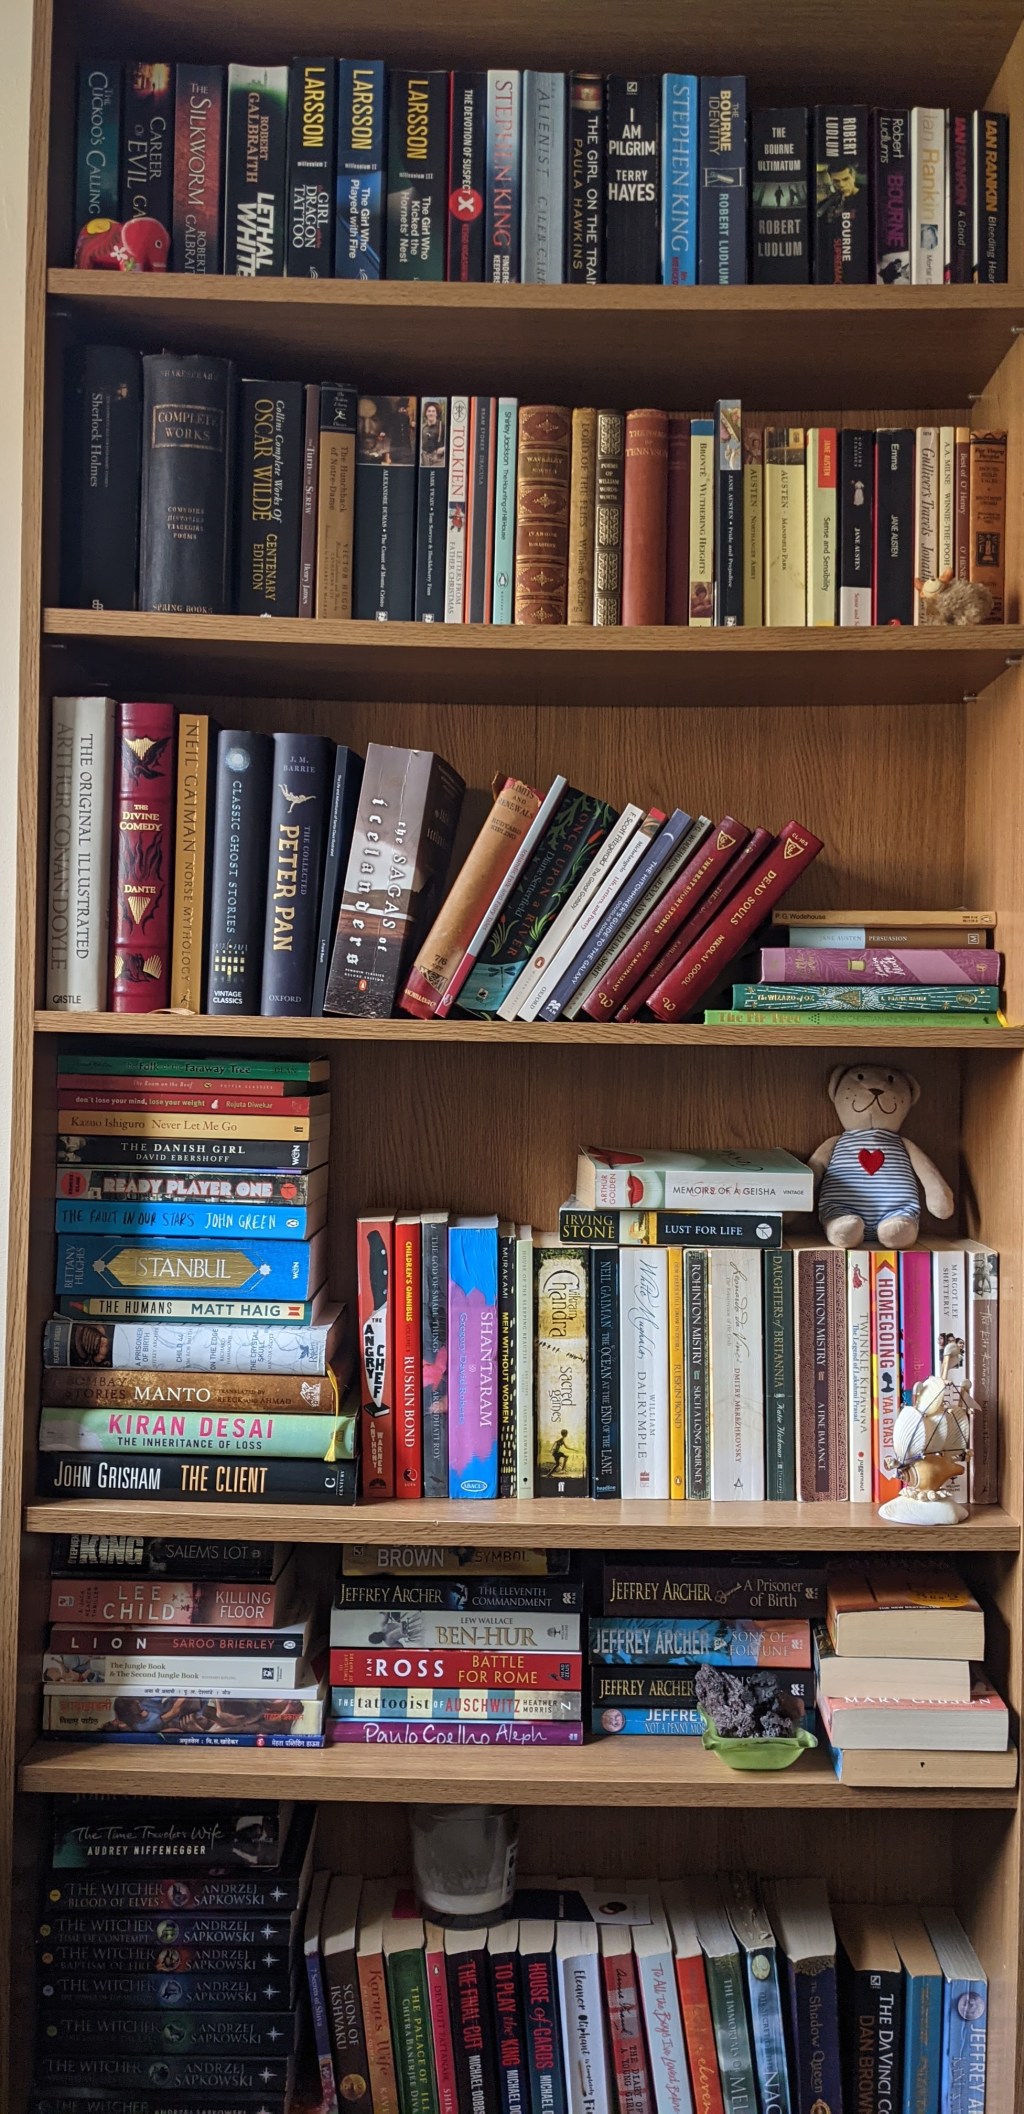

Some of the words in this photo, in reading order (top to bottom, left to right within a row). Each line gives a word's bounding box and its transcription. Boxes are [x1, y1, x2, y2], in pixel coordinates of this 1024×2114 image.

[302, 67, 326, 147] LARSSON
[351, 69, 374, 149] LARSSON
[464, 89, 473, 105] THE
[406, 80, 429, 160] LARSSON
[463, 107, 473, 144] DEVOTION
[493, 80, 513, 181] STEPHEN
[672, 84, 690, 187] STEPHEN
[720, 90, 732, 151] BOURNE
[826, 116, 839, 157] LUDLUM
[843, 117, 857, 156] ROBERT
[150, 116, 166, 180] CAREER
[188, 98, 212, 206] SILKWORM
[246, 92, 260, 183] GALBRAITH
[259, 115, 269, 161] ROBERT
[463, 146, 473, 156] OF
[608, 140, 656, 156] PILGRIM
[127, 139, 147, 189] EVIL
[462, 158, 472, 194] SUSPECT
[573, 138, 583, 189] PAULA
[616, 169, 648, 181] TERRY
[350, 179, 360, 212] Played
[360, 188, 371, 204] The
[608, 183, 655, 201] HAYES
[349, 213, 359, 236] with
[360, 207, 371, 227] Girl
[492, 189, 513, 247] KING
[671, 193, 689, 252] KING
[718, 193, 729, 236] ROBERT
[349, 238, 359, 259] Fire
[360, 229, 370, 251] Who
[572, 198, 583, 270] HAWKINS
[841, 212, 852, 262] BOURNE
[718, 240, 729, 285] LUDLUM
[91, 392, 103, 442] Sherlock
[253, 399, 274, 460] OSCAR
[504, 411, 512, 435] Shirley
[164, 427, 210, 441] WORKS
[90, 444, 102, 488] Holmes
[452, 427, 465, 498] TOLKIEN
[501, 438, 509, 466] Jackson
[890, 443, 900, 470] Emma
[252, 465, 273, 522] WILDE
[699, 483, 708, 536] WUTHERING
[823, 517, 831, 538] Sense
[890, 514, 899, 532] JANE
[942, 492, 951, 567] WINNIE-THE-POOH
[698, 537, 707, 575] HEIGHTS
[890, 533, 899, 558] AUSTEN
[252, 543, 264, 591] EDITION
[265, 533, 277, 601] CENTENARY
[80, 734, 94, 766] THE
[184, 723, 200, 771] NEIL
[283, 764, 316, 774] BARRIE
[78, 770, 93, 845] ORIGINAL
[122, 811, 160, 821] DIVINE
[182, 775, 198, 856] GAIMAN
[230, 780, 242, 831] CLASSIC
[119, 821, 162, 832] COMEDY
[228, 834, 240, 878] GHOST
[272, 824, 300, 901] PETER
[124, 884, 156, 894] DANTE
[184, 861, 195, 902] NORSE
[753, 869, 778, 898] DEAD
[76, 852, 92, 960] ILLUSTRATED
[226, 881, 239, 935] STORIES
[730, 895, 756, 927] SOULS
[50, 897, 69, 971] DOYLE
[273, 906, 296, 952] PAN
[181, 906, 194, 987] MYTHOLOGY
[700, 934, 726, 964] NIKOLAI
[680, 963, 702, 987] GOGOL
[212, 997, 244, 1005] CLASSICS
[213, 990, 243, 998] VINTAGE
[71, 1117, 103, 1127] Kazuo
[104, 1118, 145, 1130] Ishiguro
[151, 1120, 182, 1130] Never
[183, 1121, 201, 1131] Let
[202, 1121, 220, 1131] Me
[221, 1121, 238, 1131] Go
[136, 1153, 167, 1162] DAVID
[170, 1154, 231, 1163] EBERSHOFF
[153, 1143, 206, 1153] DANISH
[212, 1145, 246, 1155] GIRL
[562, 1226, 615, 1240] STONE
[664, 1224, 693, 1235] LUST
[695, 1225, 718, 1236] FOR
[720, 1225, 743, 1237] LIFE
[405, 1240, 413, 1284] CHILDREN'S
[501, 1246, 509, 1300] MURAKAMI
[99, 1300, 120, 1314] THE
[124, 1301, 173, 1315] HUMANS
[190, 1303, 235, 1316] MATT
[240, 1304, 282, 1317] HAIG
[405, 1286, 413, 1322] OMNIBUS
[878, 1278, 895, 1369] HOMEGOING
[816, 1327, 826, 1367] MISTRY
[403, 1355, 416, 1406] RUSKIN
[479, 1311, 494, 1428] SHANTARAM
[133, 1386, 211, 1403] MANTO
[501, 1383, 509, 1424] WOMEN
[883, 1395, 893, 1416] YAA
[109, 1413, 186, 1436] KIRAN
[199, 1417, 274, 1439] DESAI
[403, 1409, 416, 1448] BOND
[637, 1371, 647, 1459] DALRYMPLE
[118, 1437, 137, 1446] THE
[142, 1438, 213, 1449] INHERITANCE
[218, 1440, 231, 1449] OF
[236, 1440, 262, 1450] LOSS
[883, 1418, 894, 1448] GYASI
[215, 1591, 271, 1605] KILLING
[498, 1587, 547, 1597] ELEVENTH
[609, 1578, 660, 1602] JEFFREY
[662, 1579, 713, 1602] ARCHER
[103, 1603, 175, 1621] CHILD
[220, 1605, 265, 1619] FLOOR
[478, 1617, 514, 1625] WALLACE
[435, 1625, 538, 1647] BEN-HUR
[124, 1662, 148, 1671] Jungle
[130, 1671, 156, 1679] Second
[375, 1658, 444, 1677] ROSS
[458, 1670, 488, 1684] FOR
[494, 1671, 538, 1684] ROME
[472, 1656, 525, 1669] BATTLE
[357, 1696, 430, 1710] tattooist
[445, 1698, 521, 1714] AUSCHWITZ
[523, 1706, 553, 1714] MORRIS
[363, 1722, 419, 1744] Paulo
[422, 1724, 490, 1745] Coelho
[495, 1723, 548, 1745] Aleph
[87, 1845, 128, 1856] AUDREY
[133, 1845, 206, 1856] NIFFENEGGER
[193, 1893, 265, 1906] SAPKOWSKI
[202, 1882, 257, 1895] ANDRZEJ
[527, 1961, 550, 2005] HOUSE
[330, 1986, 347, 2050] IKSHVAKU
[343, 1983, 357, 2026] SCION
[879, 1993, 895, 2025] THE
[349, 2028, 359, 2047] OF
[533, 2027, 554, 2071] CARDS
[878, 2029, 894, 2052] DA
[877, 2052, 894, 2096] VINCI
[968, 2024, 987, 2098] JEFFREY
